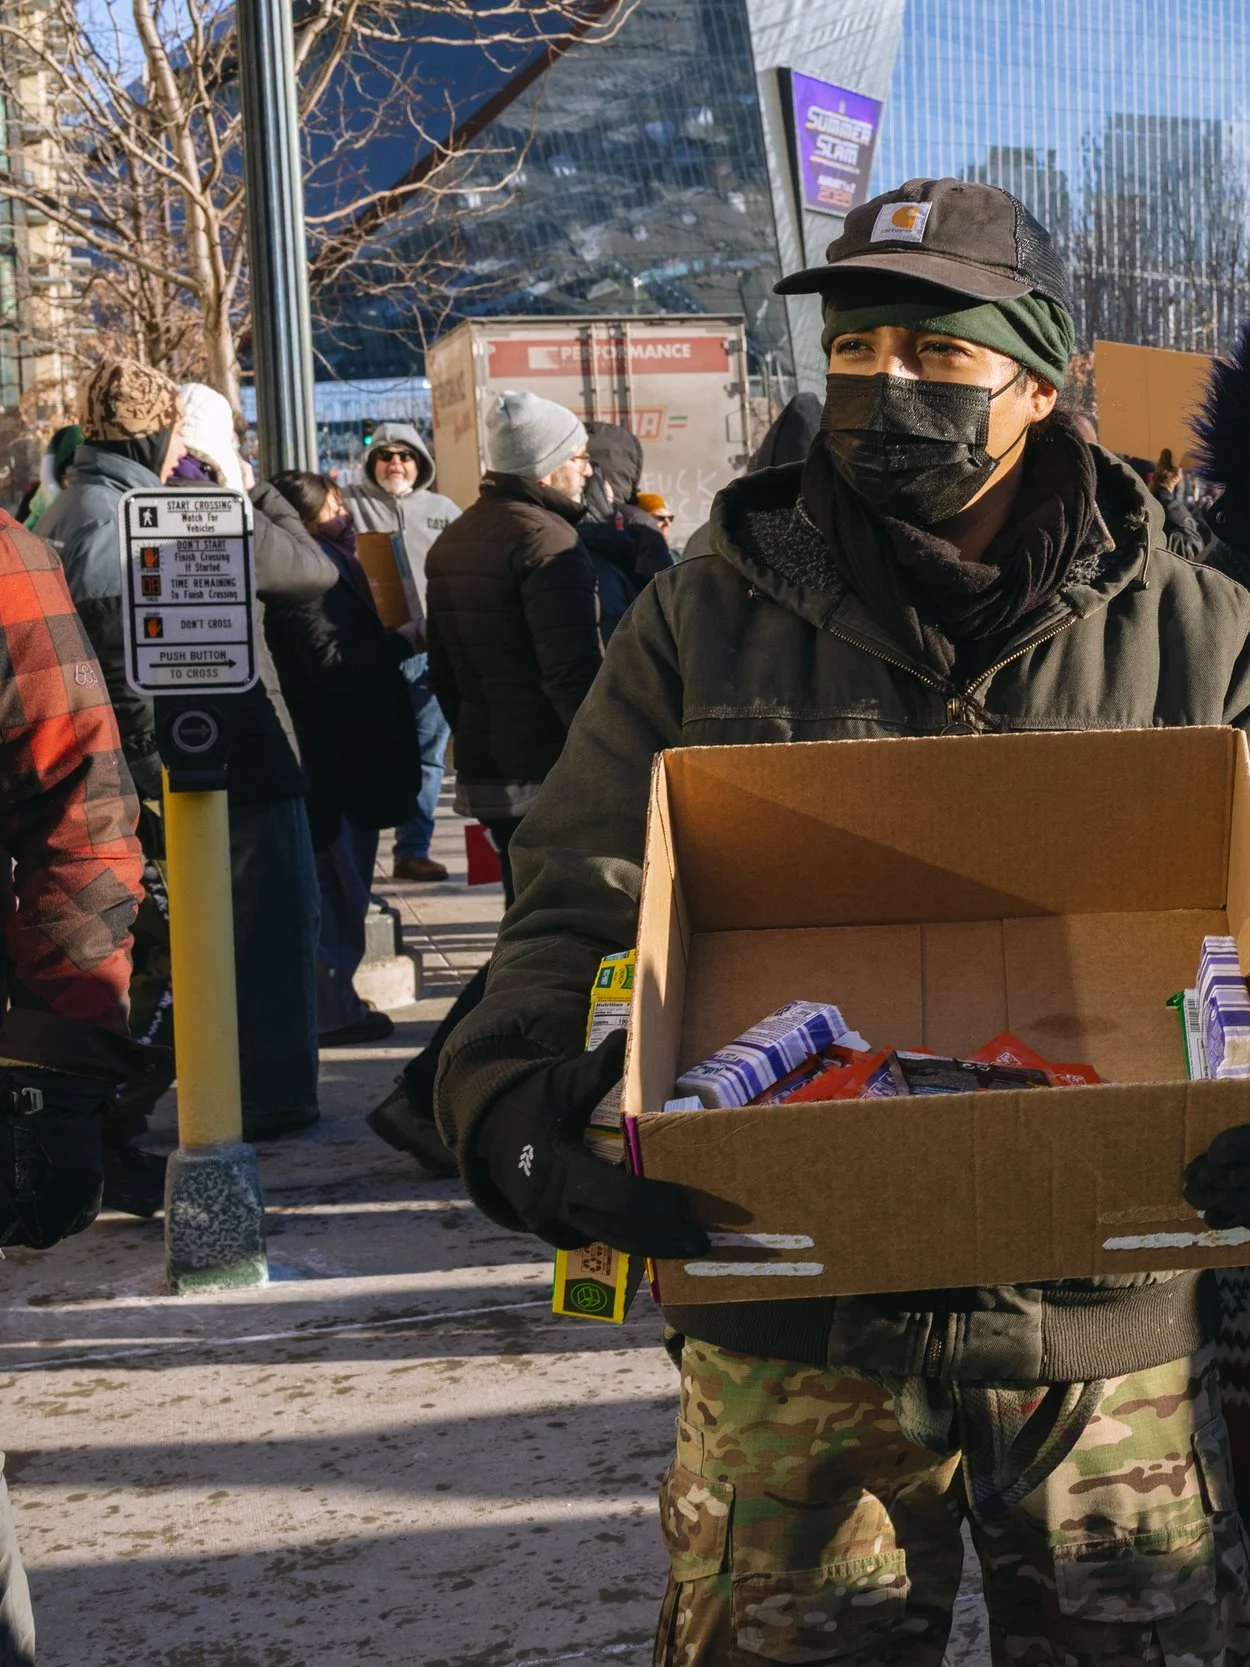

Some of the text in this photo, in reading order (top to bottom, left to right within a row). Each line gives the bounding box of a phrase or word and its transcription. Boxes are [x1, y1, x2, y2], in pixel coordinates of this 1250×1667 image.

[806, 105, 873, 146] SUMMER
[815, 133, 860, 166] SLAM
[167, 501, 232, 510] START CROSSING
[182, 513, 218, 522] Watch For
[187, 524, 215, 533] Vehicles
[177, 540, 226, 550] DON'T START
[175, 552, 230, 563] Finish Crossing
[195, 562, 221, 572] Started
[171, 578, 236, 588] TIME REMAINING
[171, 590, 238, 600] To Finish Crossing
[181, 619, 232, 629] DON'T CROSS
[160, 651, 227, 661] PUSH BUTTON
[170, 669, 218, 679] TO CROSS
